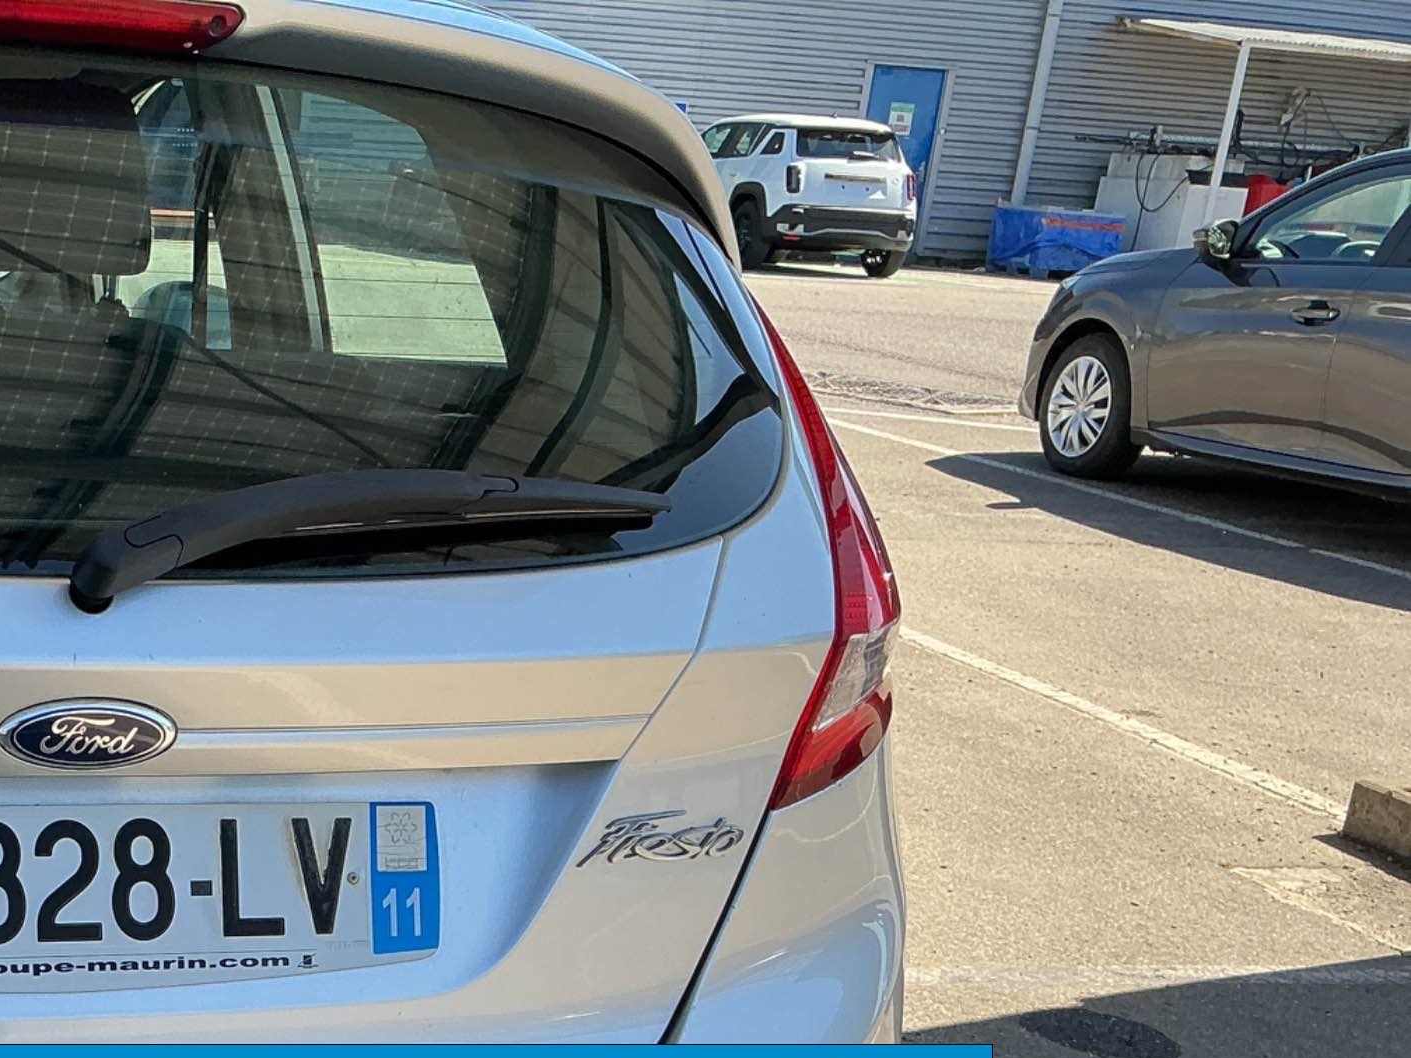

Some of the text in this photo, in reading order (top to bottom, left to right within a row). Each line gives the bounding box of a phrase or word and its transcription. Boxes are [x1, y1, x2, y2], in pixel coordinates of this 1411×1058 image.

[40, 715, 139, 755] Ford
[575, 808, 745, 868] Fiesta
[382, 887, 422, 937] 11
